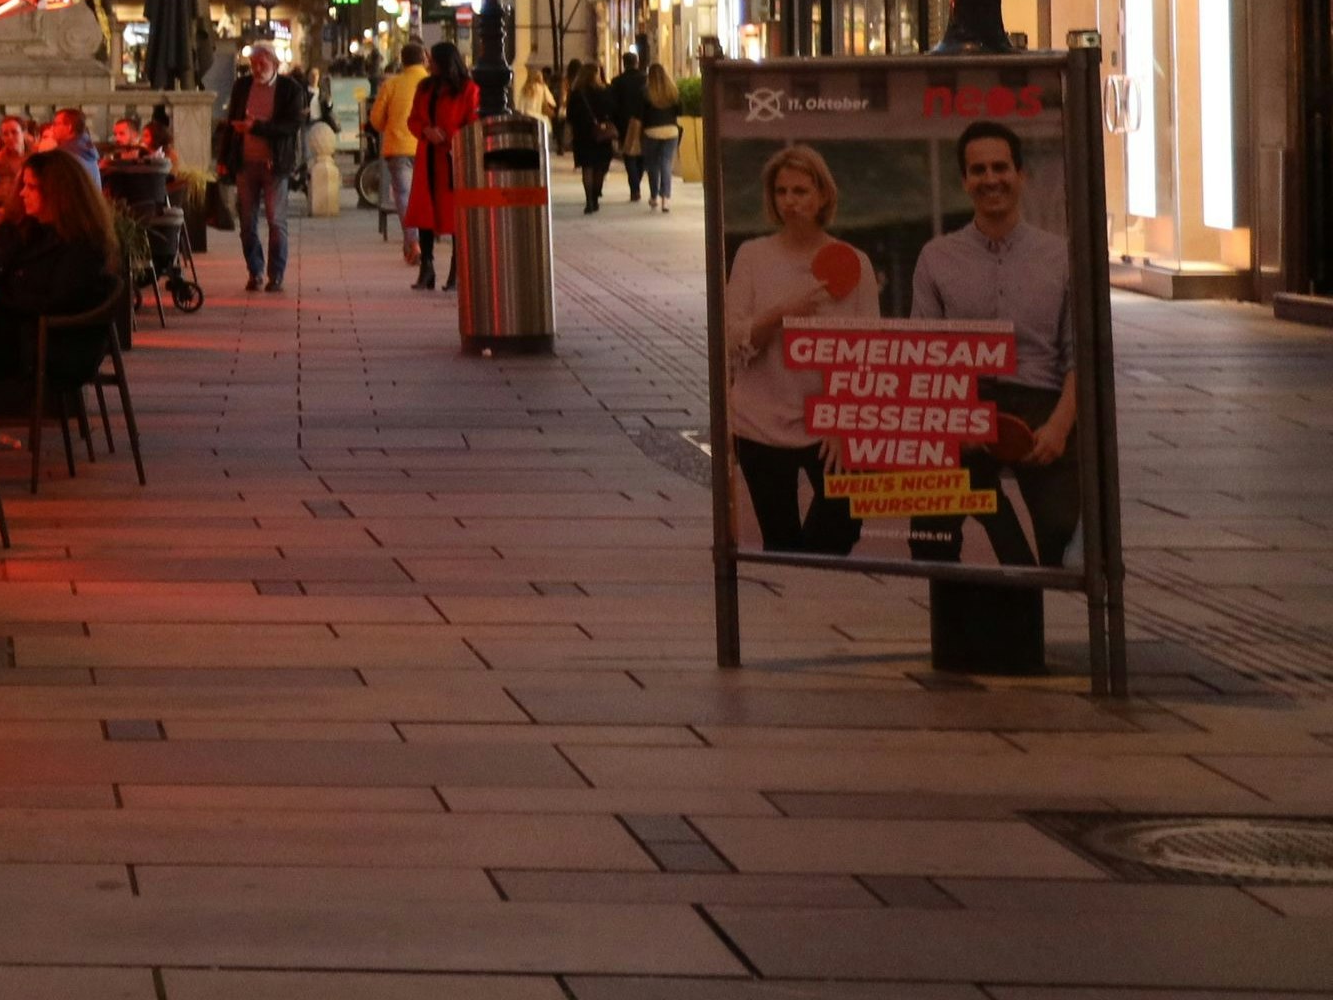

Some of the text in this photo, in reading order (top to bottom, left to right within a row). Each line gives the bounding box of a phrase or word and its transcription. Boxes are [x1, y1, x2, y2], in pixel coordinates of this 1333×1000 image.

[787, 97, 870, 112] 11. Oktober
[923, 85, 1043, 120] neos
[789, 337, 1007, 368] GEMEINSAM
[828, 365, 970, 400] FÜR EIN
[812, 404, 991, 435] BESSERES
[848, 437, 955, 467] WIEN.
[828, 474, 965, 495] WEIL'S NICHT
[853, 494, 994, 515] WURSCHT IST.
